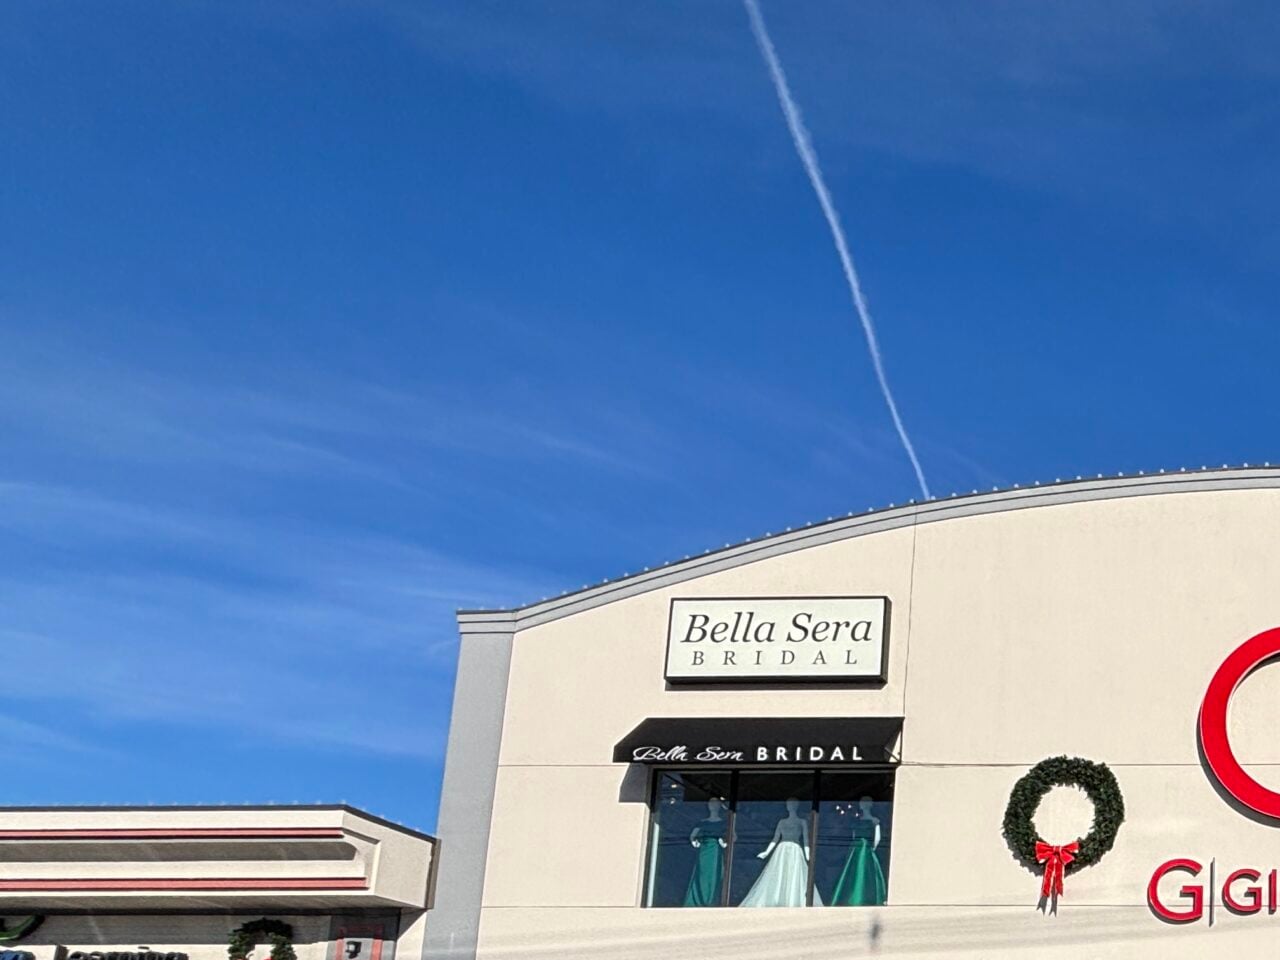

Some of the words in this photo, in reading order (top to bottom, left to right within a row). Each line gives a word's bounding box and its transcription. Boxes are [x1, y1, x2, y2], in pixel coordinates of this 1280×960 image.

[680, 611, 776, 643] Bella
[786, 612, 872, 642] Sera
[691, 650, 858, 666] BRIDAL
[632, 745, 688, 762] Bella
[696, 746, 744, 762] Sera
[756, 746, 863, 761] BRIDAL
